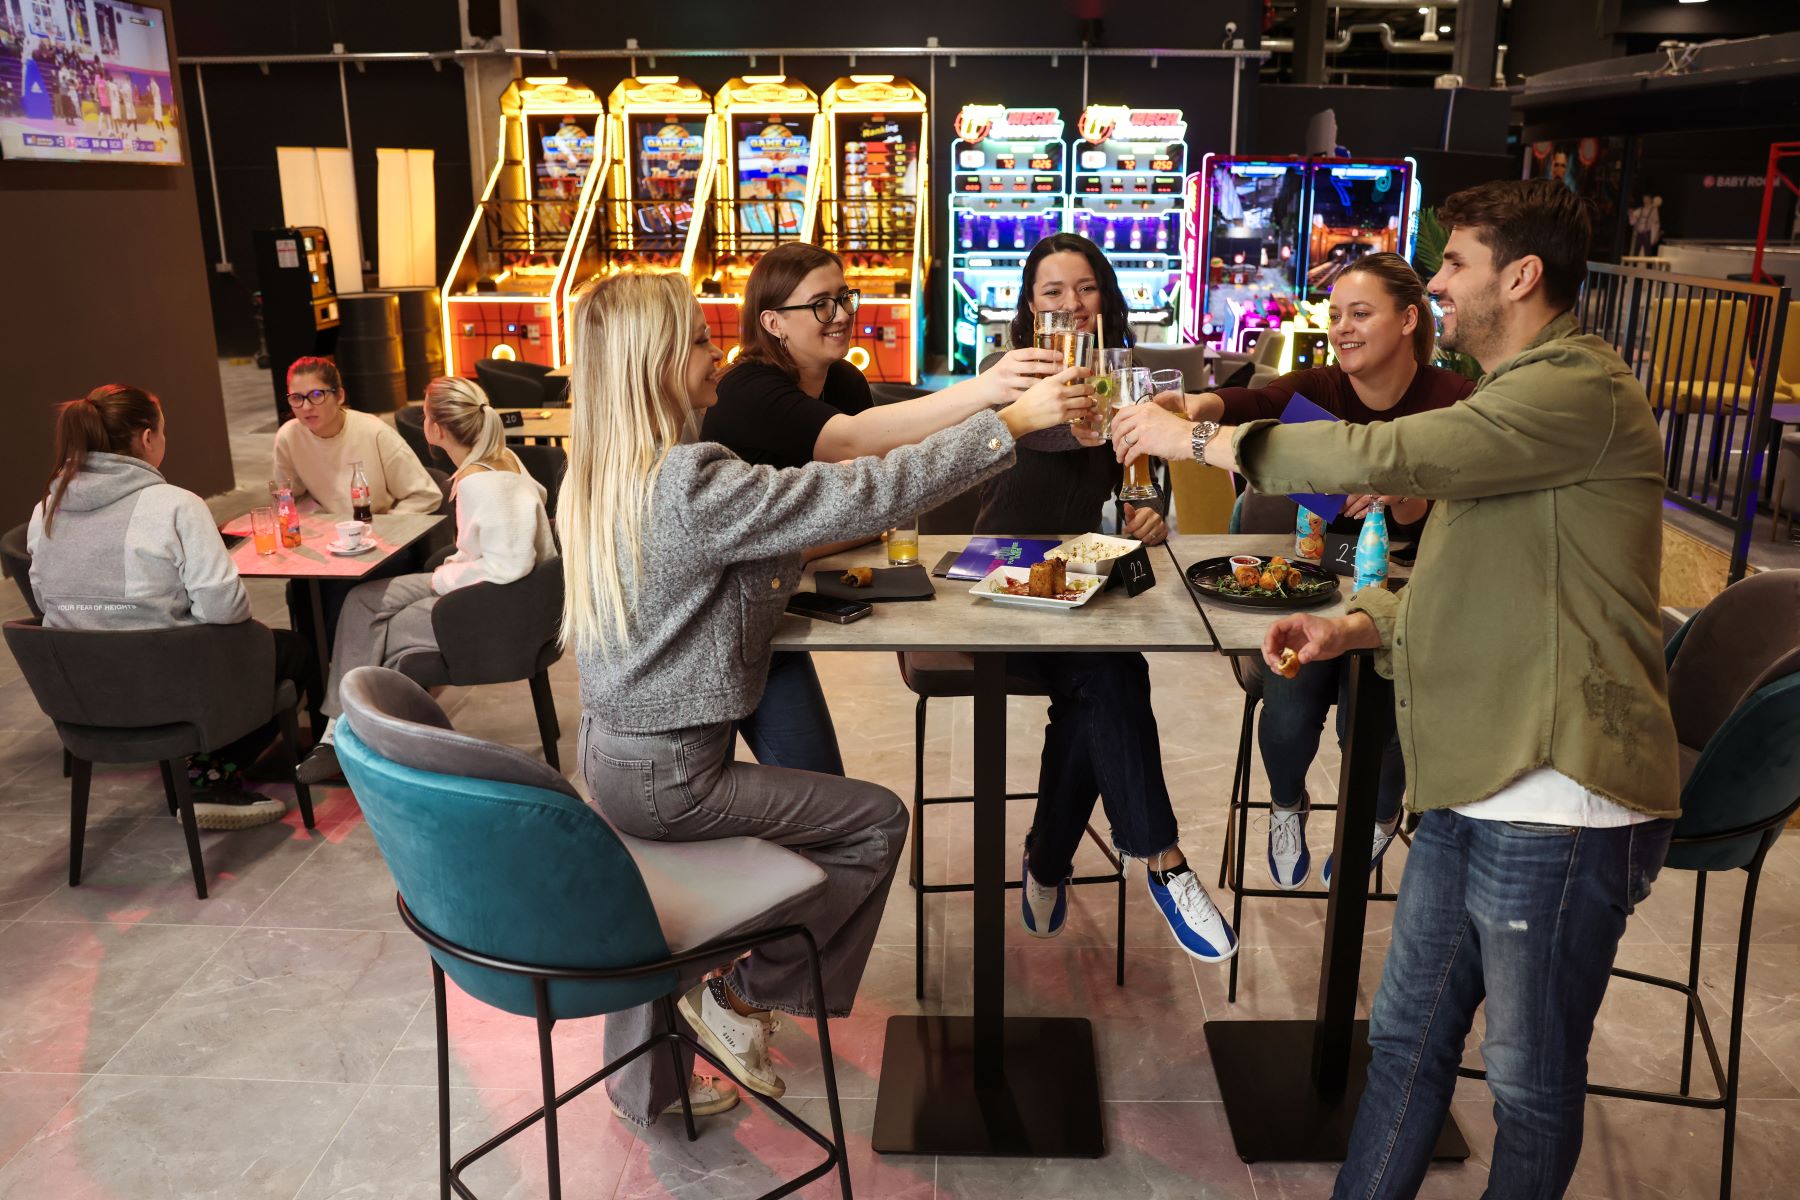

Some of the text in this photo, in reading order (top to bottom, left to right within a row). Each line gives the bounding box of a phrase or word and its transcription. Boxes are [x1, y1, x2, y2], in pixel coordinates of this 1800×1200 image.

[1031, 159, 1052, 169] 1026
[1152, 160, 1173, 170] 1050
[1716, 175, 1746, 187] BABY
[505, 415, 517, 424] 10
